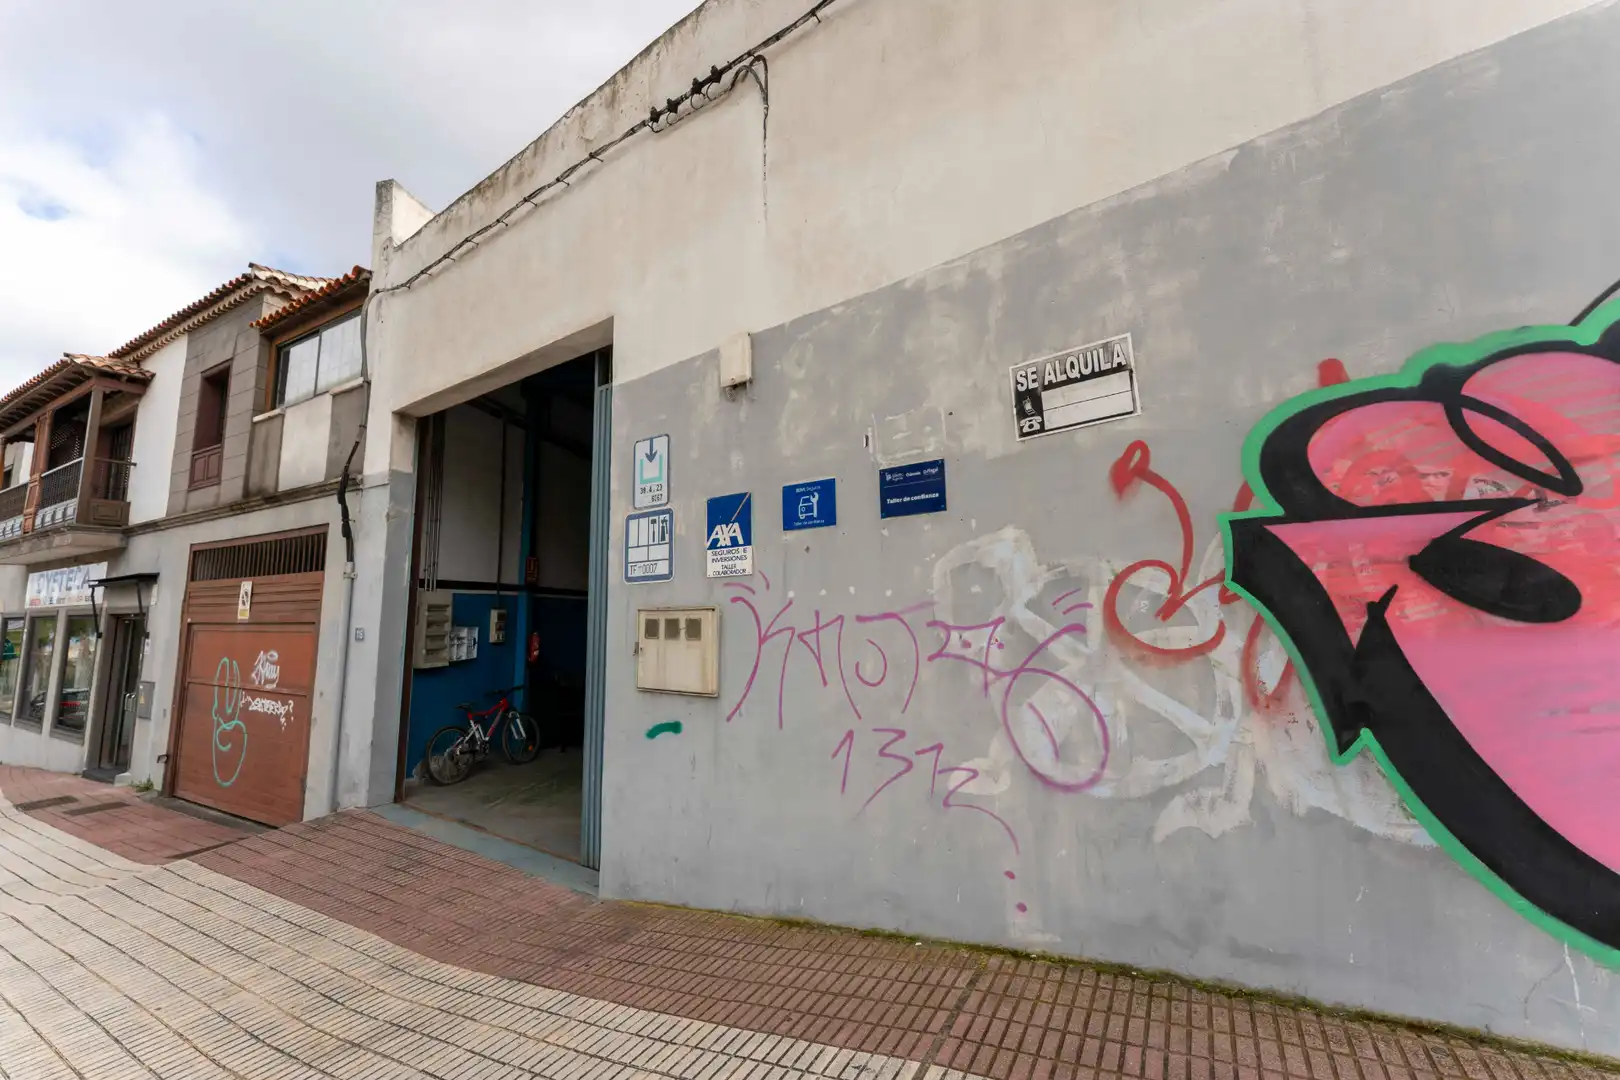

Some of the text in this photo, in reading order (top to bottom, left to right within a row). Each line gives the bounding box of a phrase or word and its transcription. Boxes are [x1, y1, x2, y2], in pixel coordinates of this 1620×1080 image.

[1016, 342, 1127, 392] SE ALQUILA
[911, 492, 939, 501] confianza
[706, 522, 745, 550] AXA
[711, 548, 740, 557] SEGUROS
[712, 555, 748, 563] INVERSIONES
